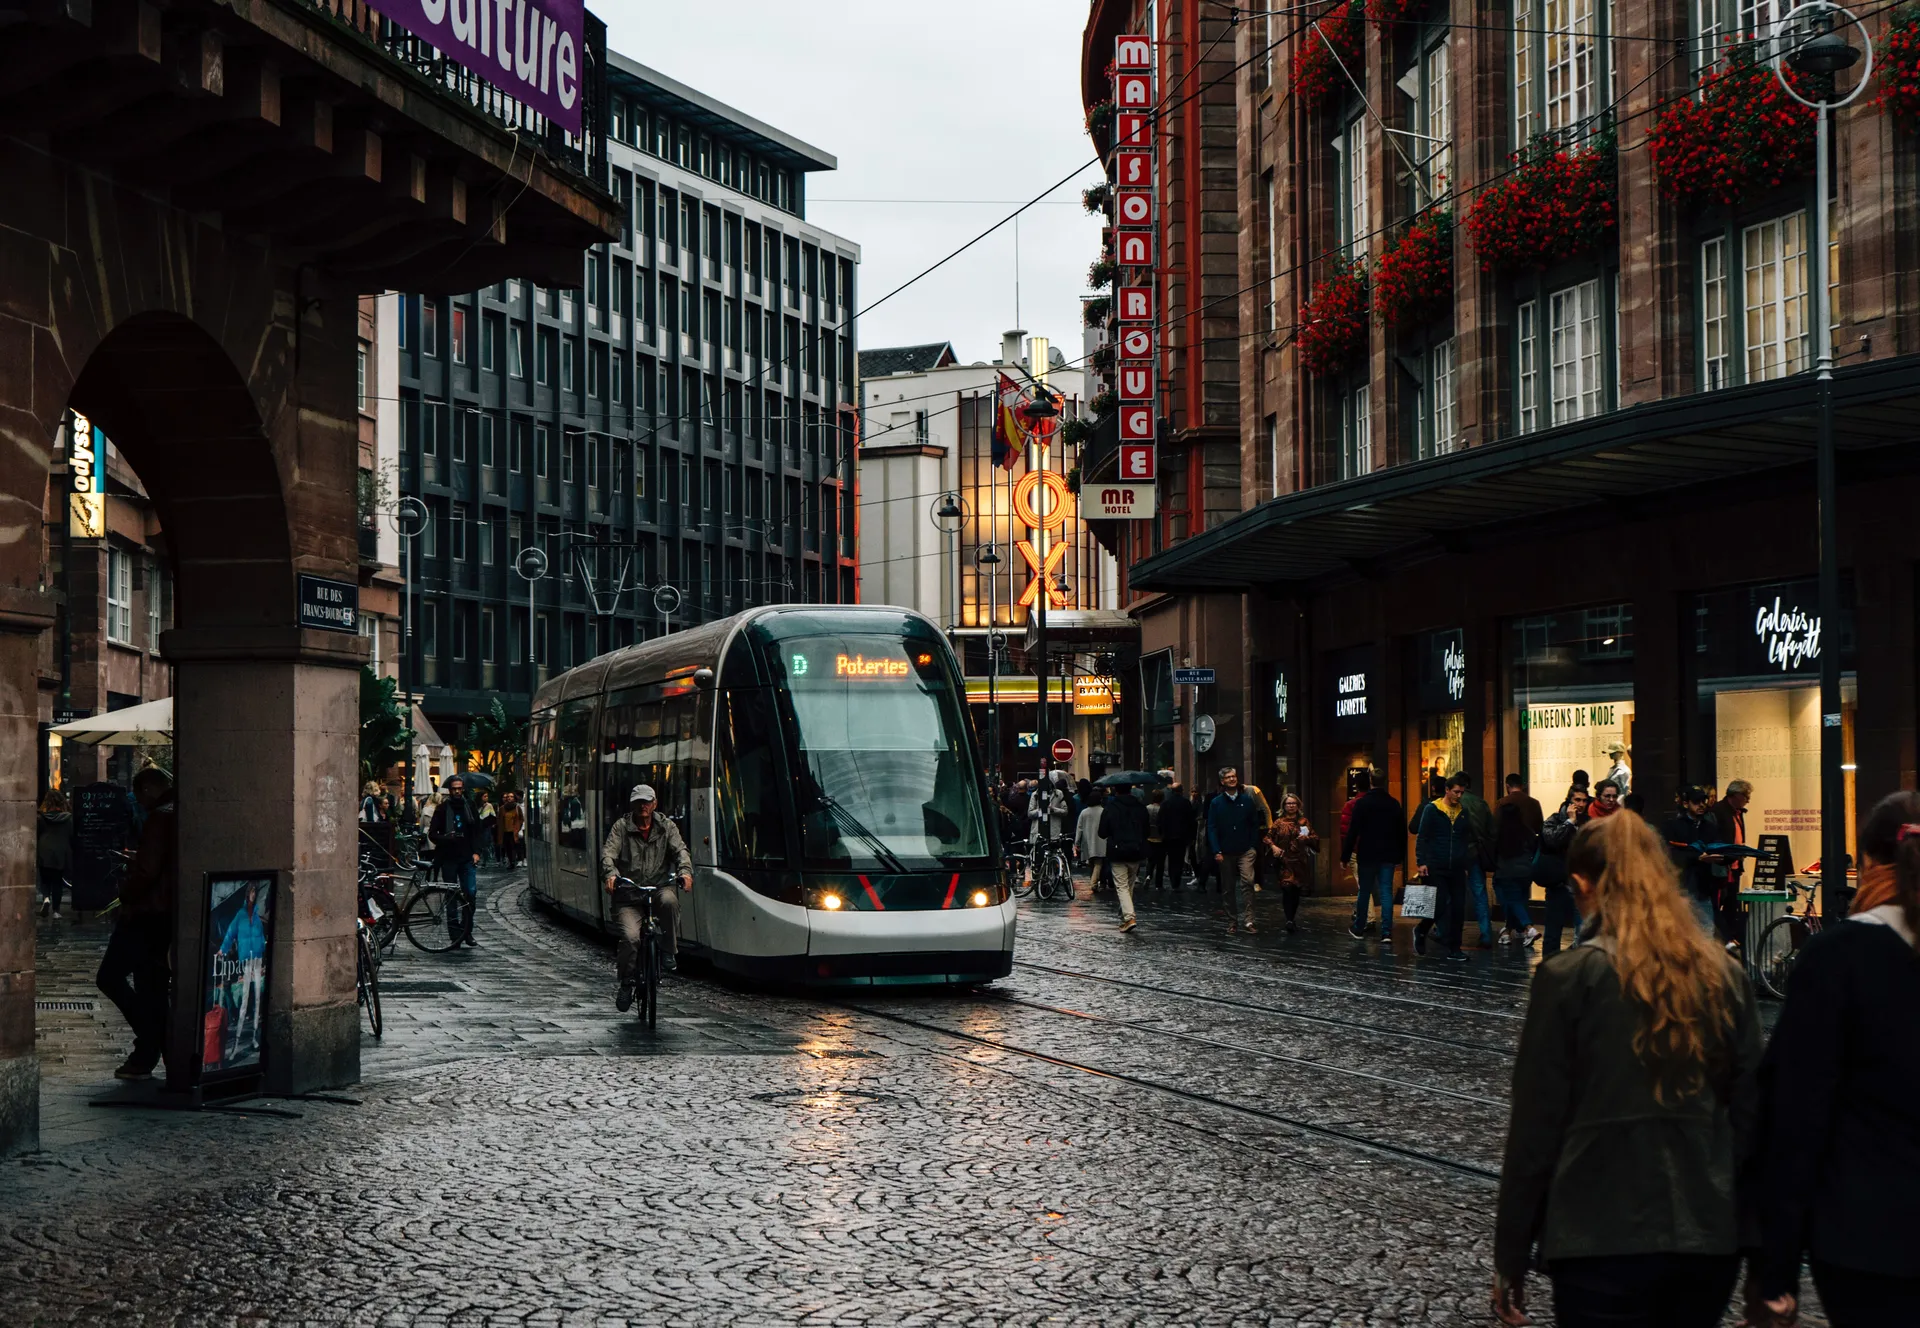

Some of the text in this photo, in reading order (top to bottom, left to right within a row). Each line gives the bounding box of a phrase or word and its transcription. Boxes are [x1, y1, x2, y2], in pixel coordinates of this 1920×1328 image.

[1119, 40, 1150, 260] MAISON
[1124, 292, 1150, 475] ROUGE
[69, 409, 95, 492] odyss
[1101, 489, 1135, 505] MR
[1104, 506, 1132, 514] HOTEL
[316, 586, 343, 603] RUE DES
[303, 603, 356, 623] FRANCS-BOURGS
[1756, 596, 1809, 643] Galeries
[1768, 617, 1821, 671] Lafayett
[792, 654, 808, 676] D
[836, 653, 909, 676] Poteries
[1076, 677, 1112, 686] ALAIN
[1079, 687, 1108, 696] BATT
[1338, 673, 1366, 694] GALERIES
[1336, 696, 1367, 717] LAFAYETTE
[1521, 705, 1615, 730] CHANGEONS DE MODE
